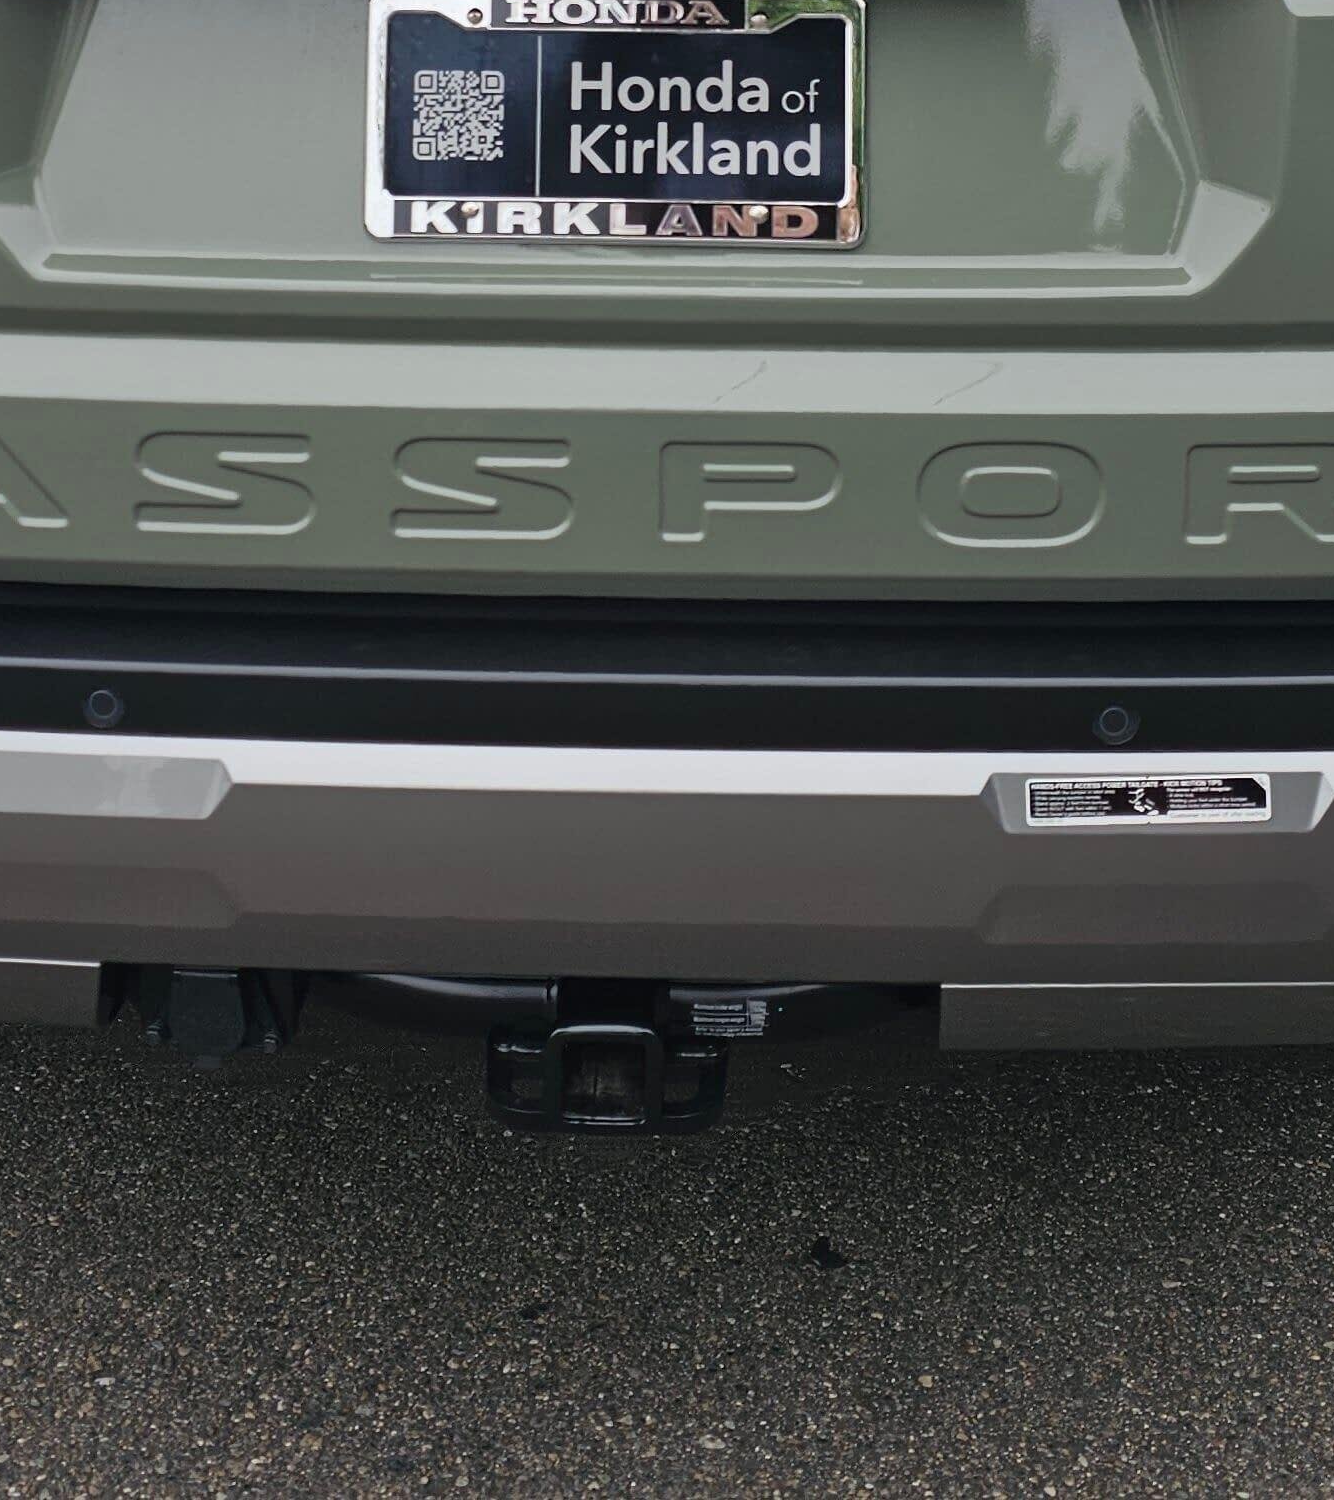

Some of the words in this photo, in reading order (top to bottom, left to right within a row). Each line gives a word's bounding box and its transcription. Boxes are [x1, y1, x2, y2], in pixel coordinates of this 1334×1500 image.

[570, 59, 770, 113] Honda
[780, 78, 821, 114] of
[569, 121, 821, 177] Kirkland
[409, 200, 820, 239] KIRKLAND
